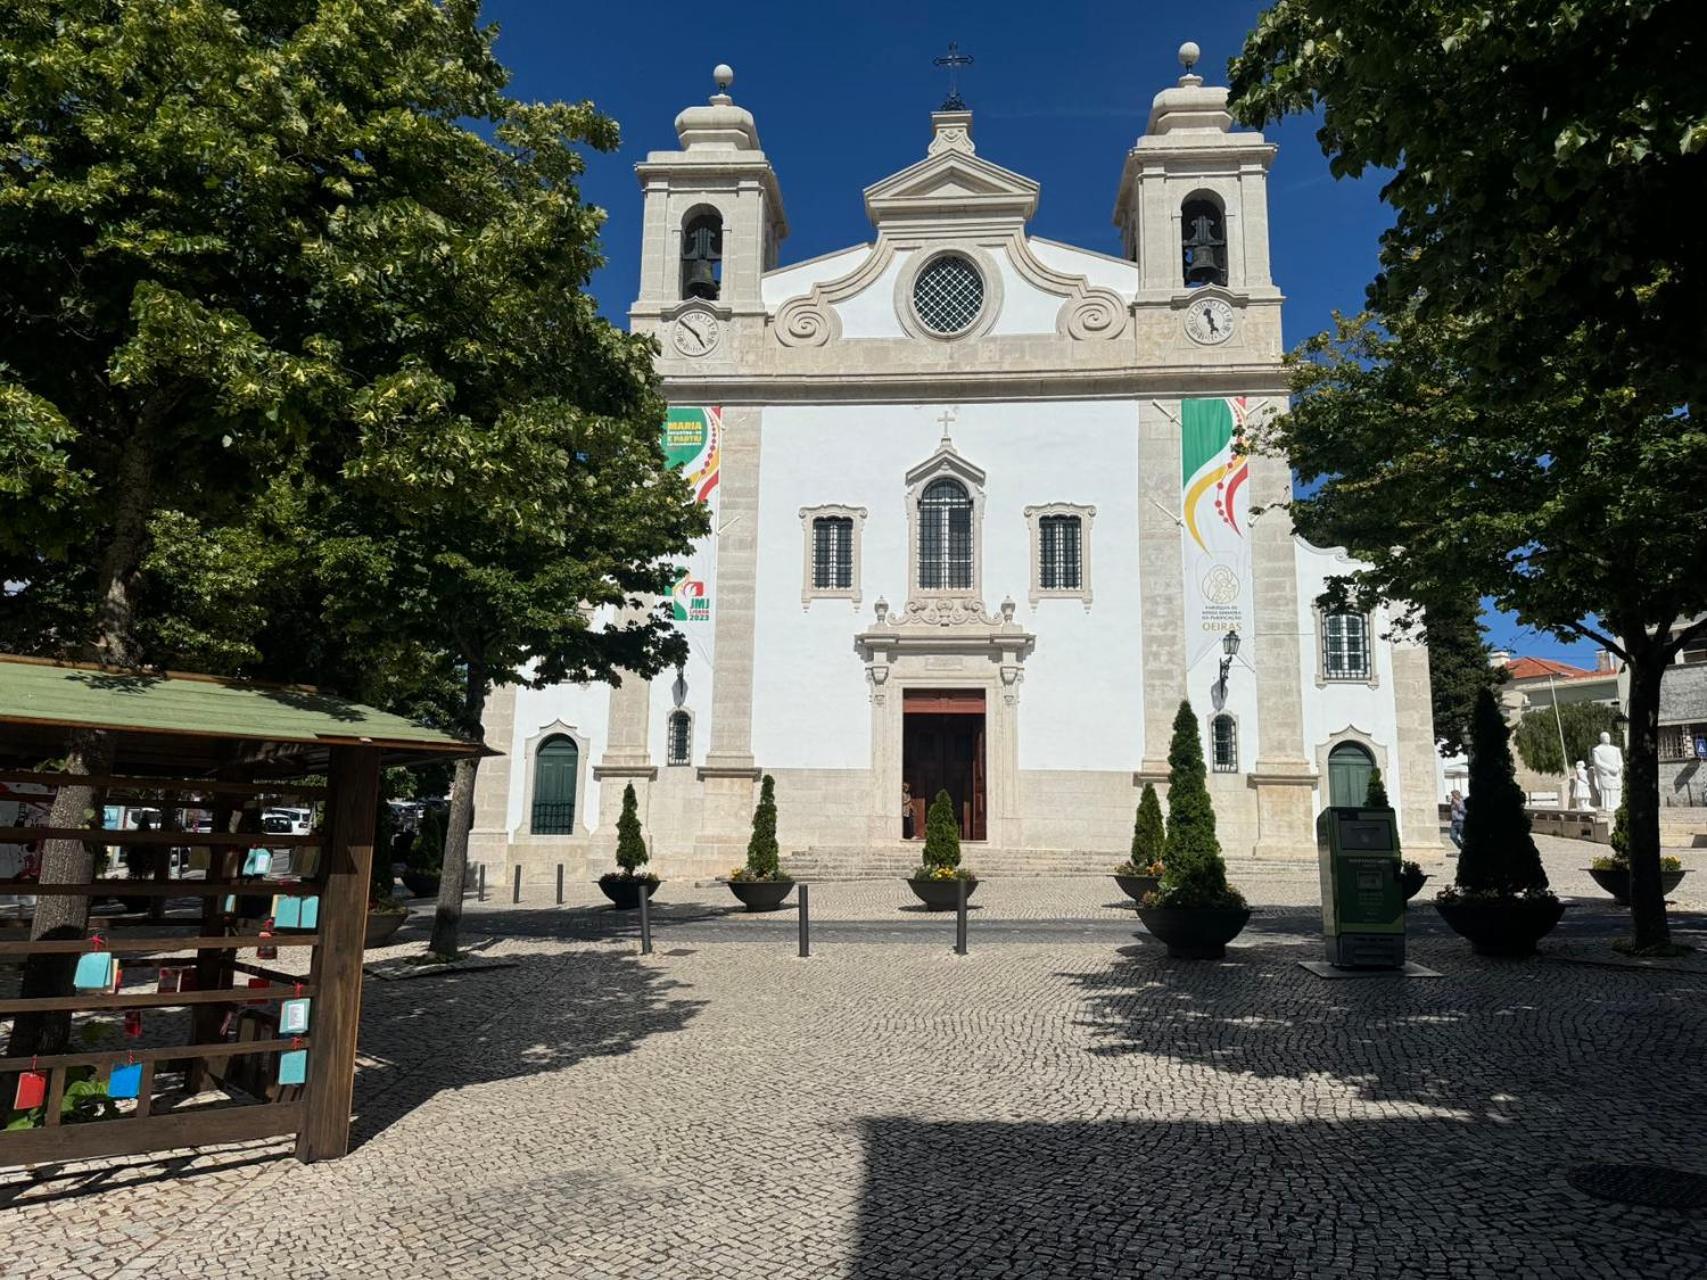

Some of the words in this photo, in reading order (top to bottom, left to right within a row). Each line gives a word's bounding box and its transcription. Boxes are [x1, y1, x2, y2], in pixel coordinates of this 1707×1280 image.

[667, 421, 702, 430] MARIA
[690, 598, 709, 609] JMJ
[1202, 622, 1242, 631] OEIRAS
